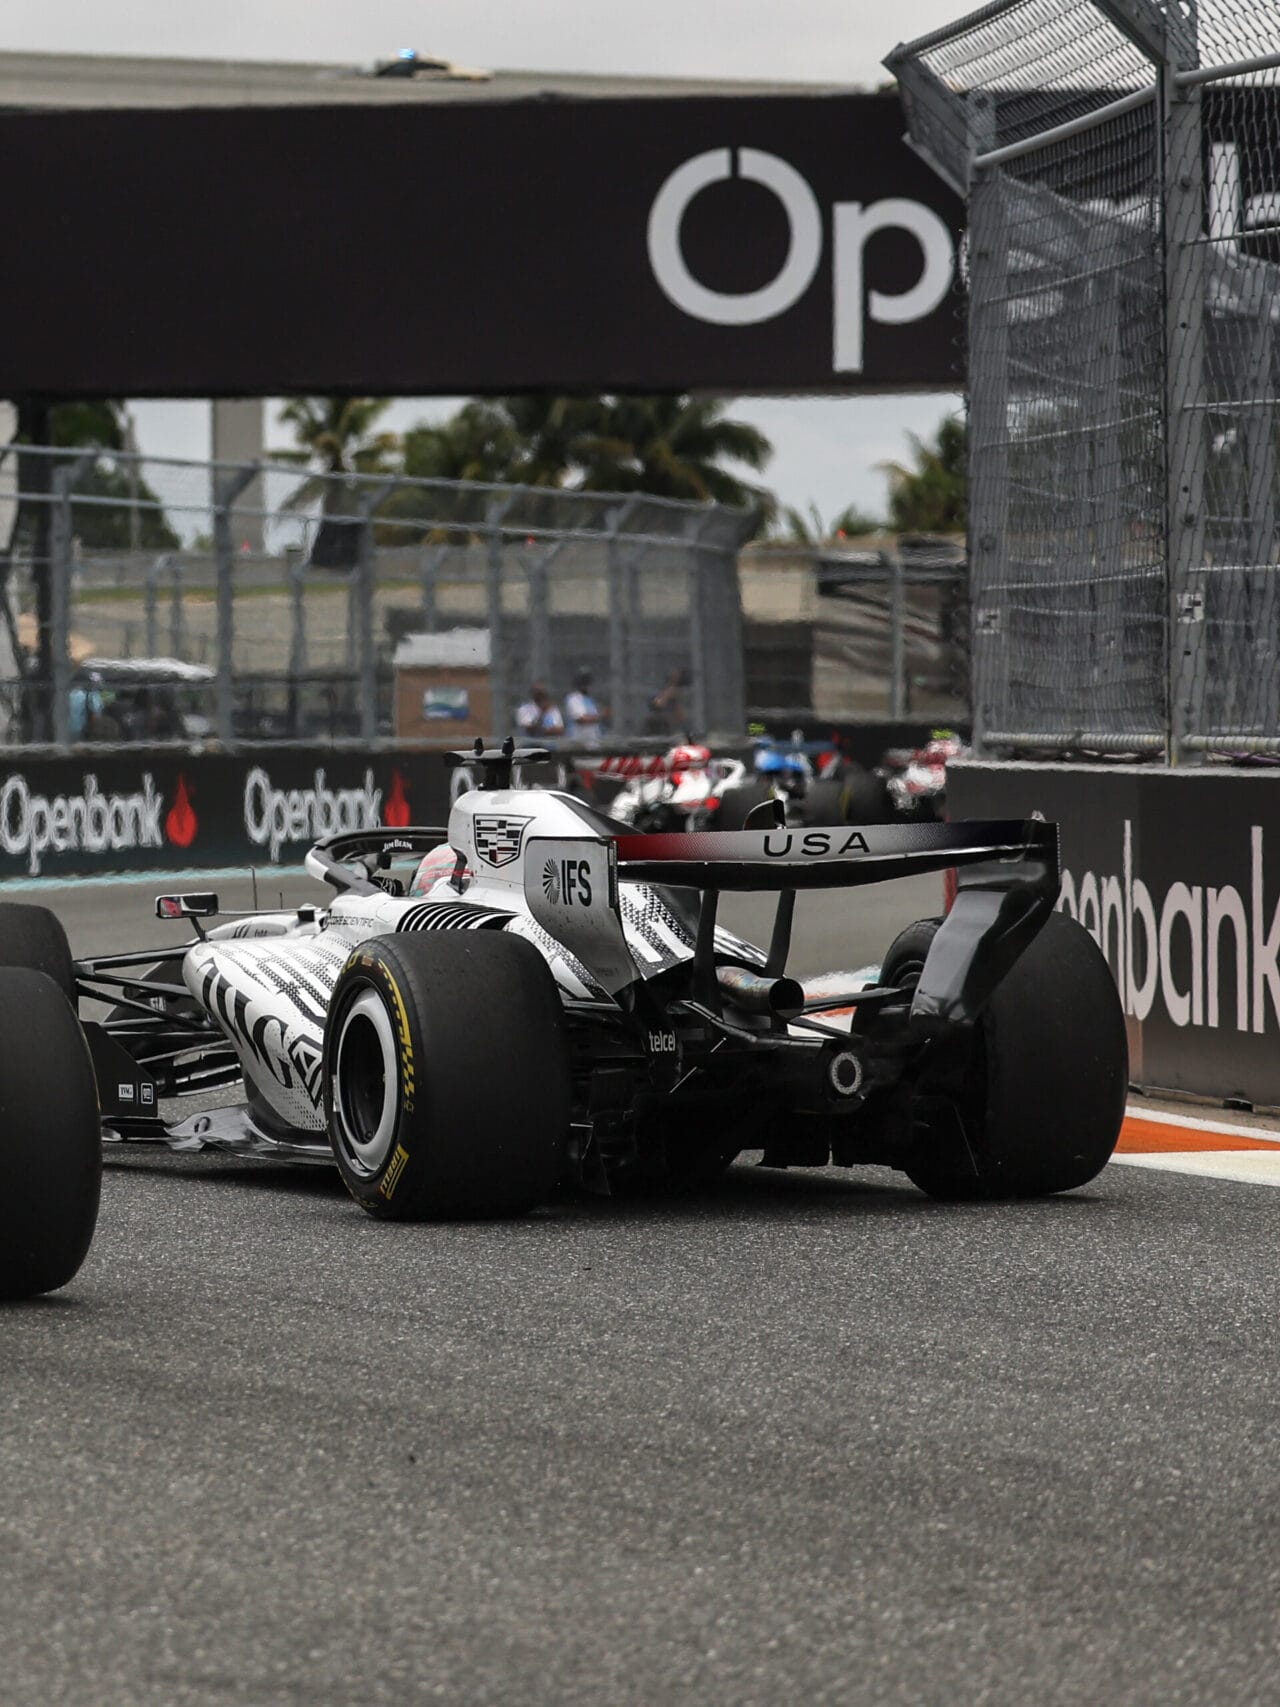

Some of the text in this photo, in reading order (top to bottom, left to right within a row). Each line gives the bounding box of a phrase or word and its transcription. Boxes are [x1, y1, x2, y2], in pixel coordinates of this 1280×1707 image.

[646, 146, 968, 374] Op
[763, 831, 871, 857] USA
[561, 859, 593, 907] IFS
[1053, 819, 1280, 1034] enbank
[648, 1030, 676, 1052] telcel
[380, 1143, 410, 1200] PIRELLI
